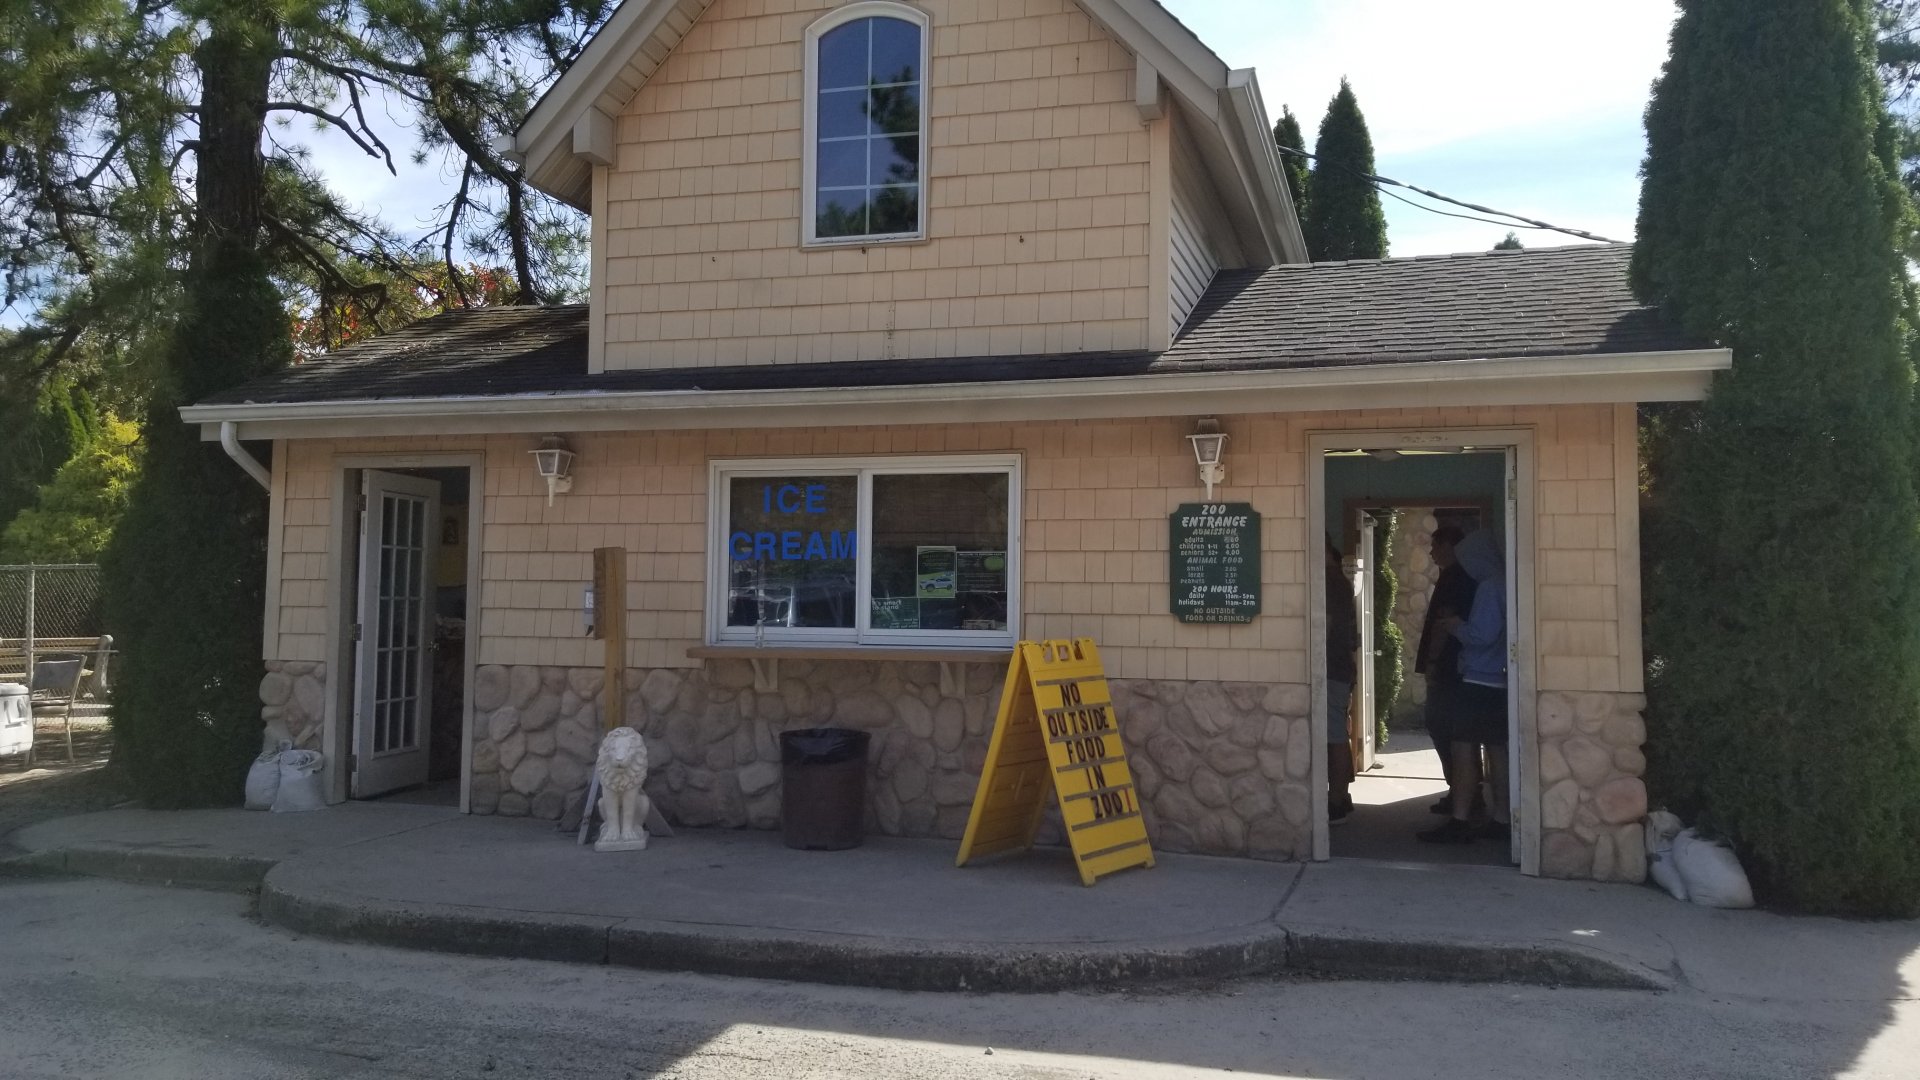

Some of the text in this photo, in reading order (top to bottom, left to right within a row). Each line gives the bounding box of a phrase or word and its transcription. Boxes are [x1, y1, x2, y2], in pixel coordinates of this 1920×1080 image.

[763, 484, 827, 514] ICE
[1201, 504, 1226, 515] ZOO
[1181, 516, 1247, 528] ENTRANCE
[1192, 528, 1237, 536] ADMISSION
[728, 531, 857, 561] CREAM
[1222, 556, 1243, 564] FOOD
[1192, 585, 1238, 594] ZOO HOURS
[1060, 682, 1081, 707] NO
[1047, 707, 1110, 737] OUTSIDE
[1066, 736, 1105, 763] FOOD
[1084, 765, 1106, 790] IN
